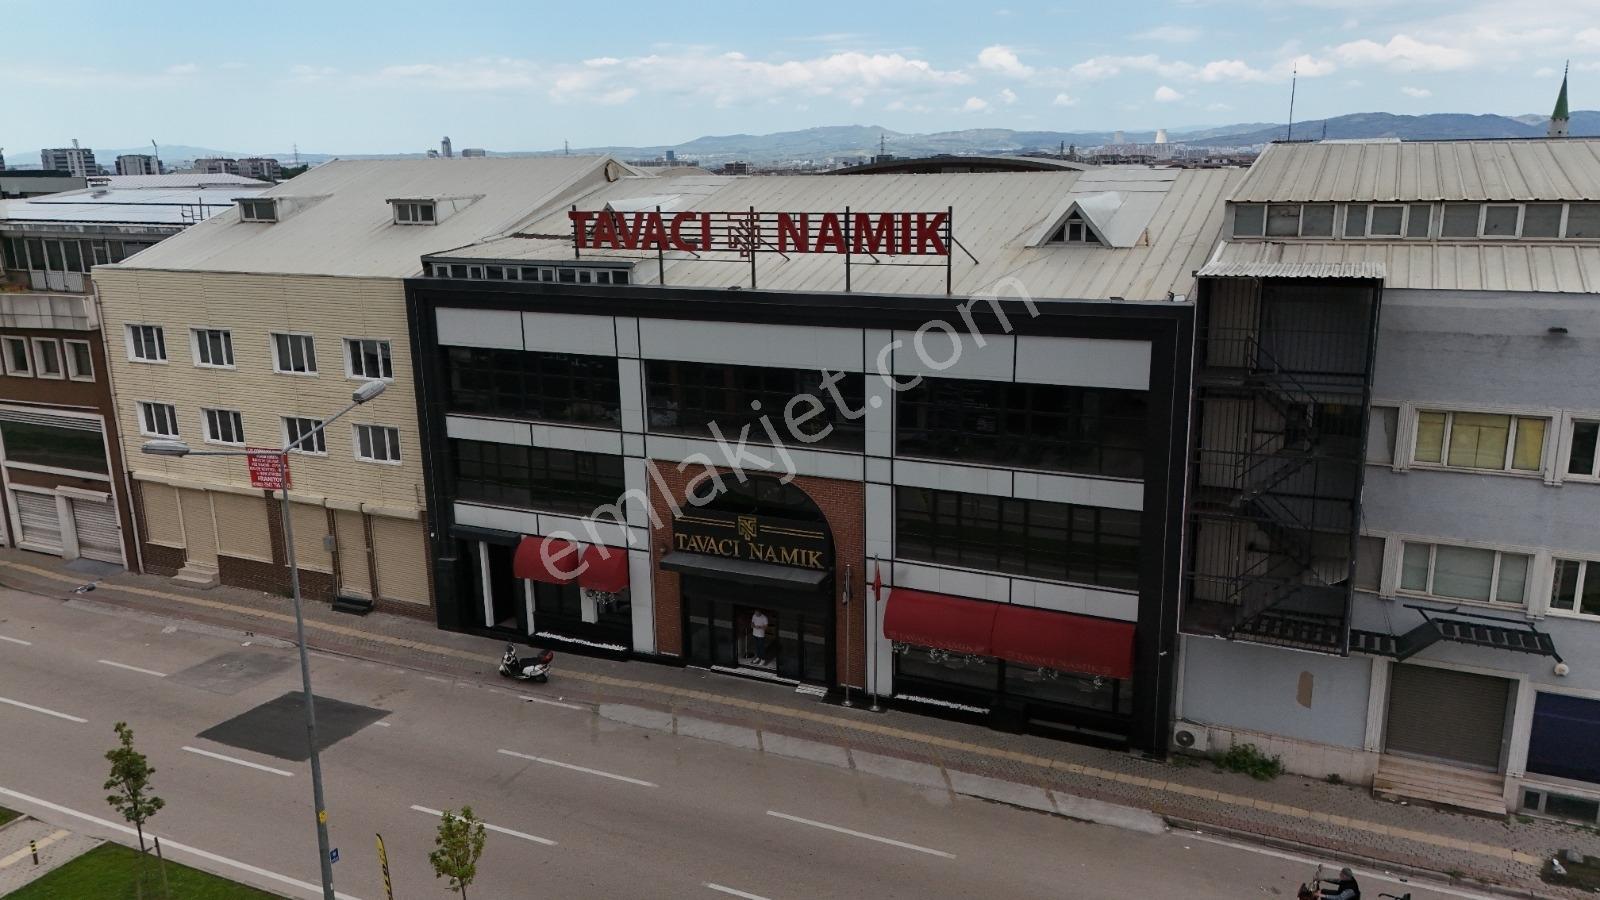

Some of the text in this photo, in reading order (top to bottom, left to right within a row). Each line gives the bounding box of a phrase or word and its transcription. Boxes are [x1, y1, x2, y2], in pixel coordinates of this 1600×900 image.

[568, 211, 950, 256] TAVACI NAMIK
[674, 533, 825, 569] TAVACI NAMIK
